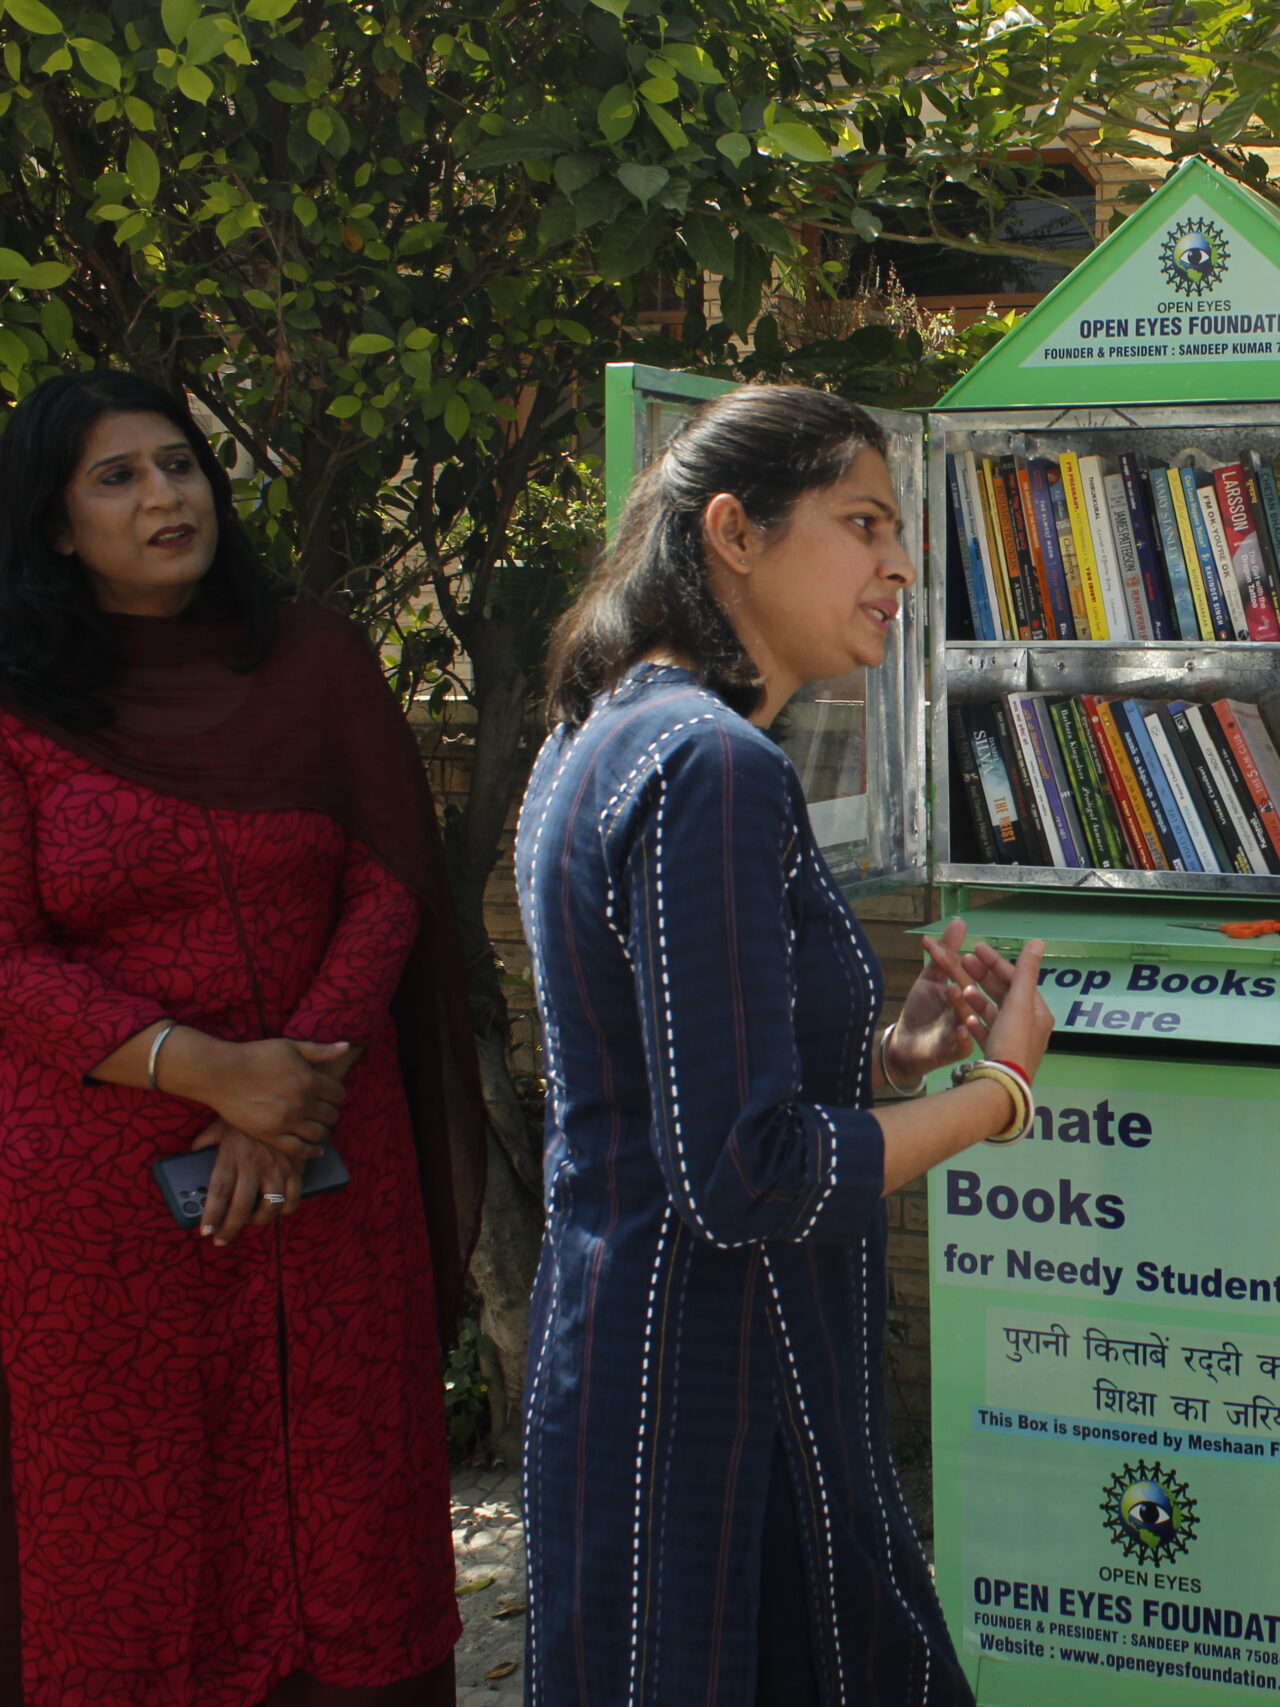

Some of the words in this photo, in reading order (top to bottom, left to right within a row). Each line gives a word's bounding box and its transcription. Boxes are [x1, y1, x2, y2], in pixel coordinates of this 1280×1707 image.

[1158, 302, 1192, 313] OPEN
[1198, 300, 1231, 312] EYES
[1080, 319, 1128, 338] OPEN
[1136, 317, 1181, 336] EYES
[1045, 348, 1093, 359] FOUNDER
[1098, 347, 1104, 358] &
[1110, 346, 1168, 357] PRESIDENT
[1179, 344, 1228, 355] SANDEEP
[1233, 343, 1271, 353] KUMAR
[1067, 473, 1080, 512] PREGNANT.
[1087, 476, 1100, 520] THIRUKKURAL
[1153, 477, 1168, 508] MARY
[1186, 487, 1195, 501] Love
[1221, 470, 1248, 531] LARSSON
[1260, 472, 1276, 511] CHETAN
[1041, 513, 1050, 537] ALMOST
[1188, 501, 1200, 526] Happen
[1003, 528, 1018, 570] FRANKLIN
[1045, 540, 1054, 558] MOON
[1160, 510, 1178, 558] STANLEY
[1195, 525, 1206, 548] Twice?
[1203, 494, 1212, 509] I'M
[1221, 563, 1230, 578] OK
[1118, 532, 1136, 572] PATTERSON
[1247, 550, 1256, 564] The
[1238, 553, 1253, 582] Dragon
[1247, 583, 1259, 608] Tattoo
[1250, 564, 1260, 579] Girl
[1254, 579, 1264, 595] with
[1204, 565, 1218, 601] RAVINDER
[1213, 602, 1223, 625] SINGH
[1258, 595, 1267, 609] the
[972, 729, 994, 777] SILVA
[988, 736, 999, 761] DANIEL
[1232, 732, 1247, 754] CLUB
[1242, 755, 1253, 769] AM
[1246, 768, 1258, 779] 5
[1059, 708, 1075, 739] Barbara
[1067, 739, 1087, 780] Kingsolver
[1078, 784, 1097, 821] Prodigal
[1091, 822, 1106, 852] Summer
[1251, 777, 1263, 793] THE
[992, 796, 1008, 814] THE
[997, 815, 1015, 843] HEIST
[1037, 967, 1112, 996] rop
[1127, 963, 1277, 998] Books
[1065, 1001, 1182, 1033] Here
[1025, 1099, 1153, 1149] nate
[947, 1170, 1125, 1229] Books
[944, 1244, 994, 1275] for
[1007, 1250, 1123, 1295] Needy
[1003, 1324, 1070, 1362] पुरानी
[1084, 1328, 1169, 1368] किताबें
[1093, 1378, 1157, 1416] शिक्षा
[1171, 1396, 1209, 1422] का
[979, 1410, 1012, 1427] This
[1019, 1415, 1047, 1432] Box
[1054, 1419, 1067, 1434] is
[1073, 1426, 1157, 1445] sponsored
[1164, 1432, 1182, 1451] by
[1189, 1435, 1264, 1455] Meshaan
[1099, 1567, 1147, 1586] OPEN
[1155, 1574, 1201, 1593] EYES
[975, 1577, 1048, 1612] OPEN
[1060, 1588, 1131, 1623] EYES
[975, 1612, 1031, 1631] FOUNDER
[1036, 1621, 1044, 1633] &
[1050, 1623, 1118, 1643] PRESIDENT
[1131, 1633, 1190, 1653] SANDEEP
[1194, 1643, 1240, 1660] KUMAR
[980, 1632, 1044, 1657] Website
